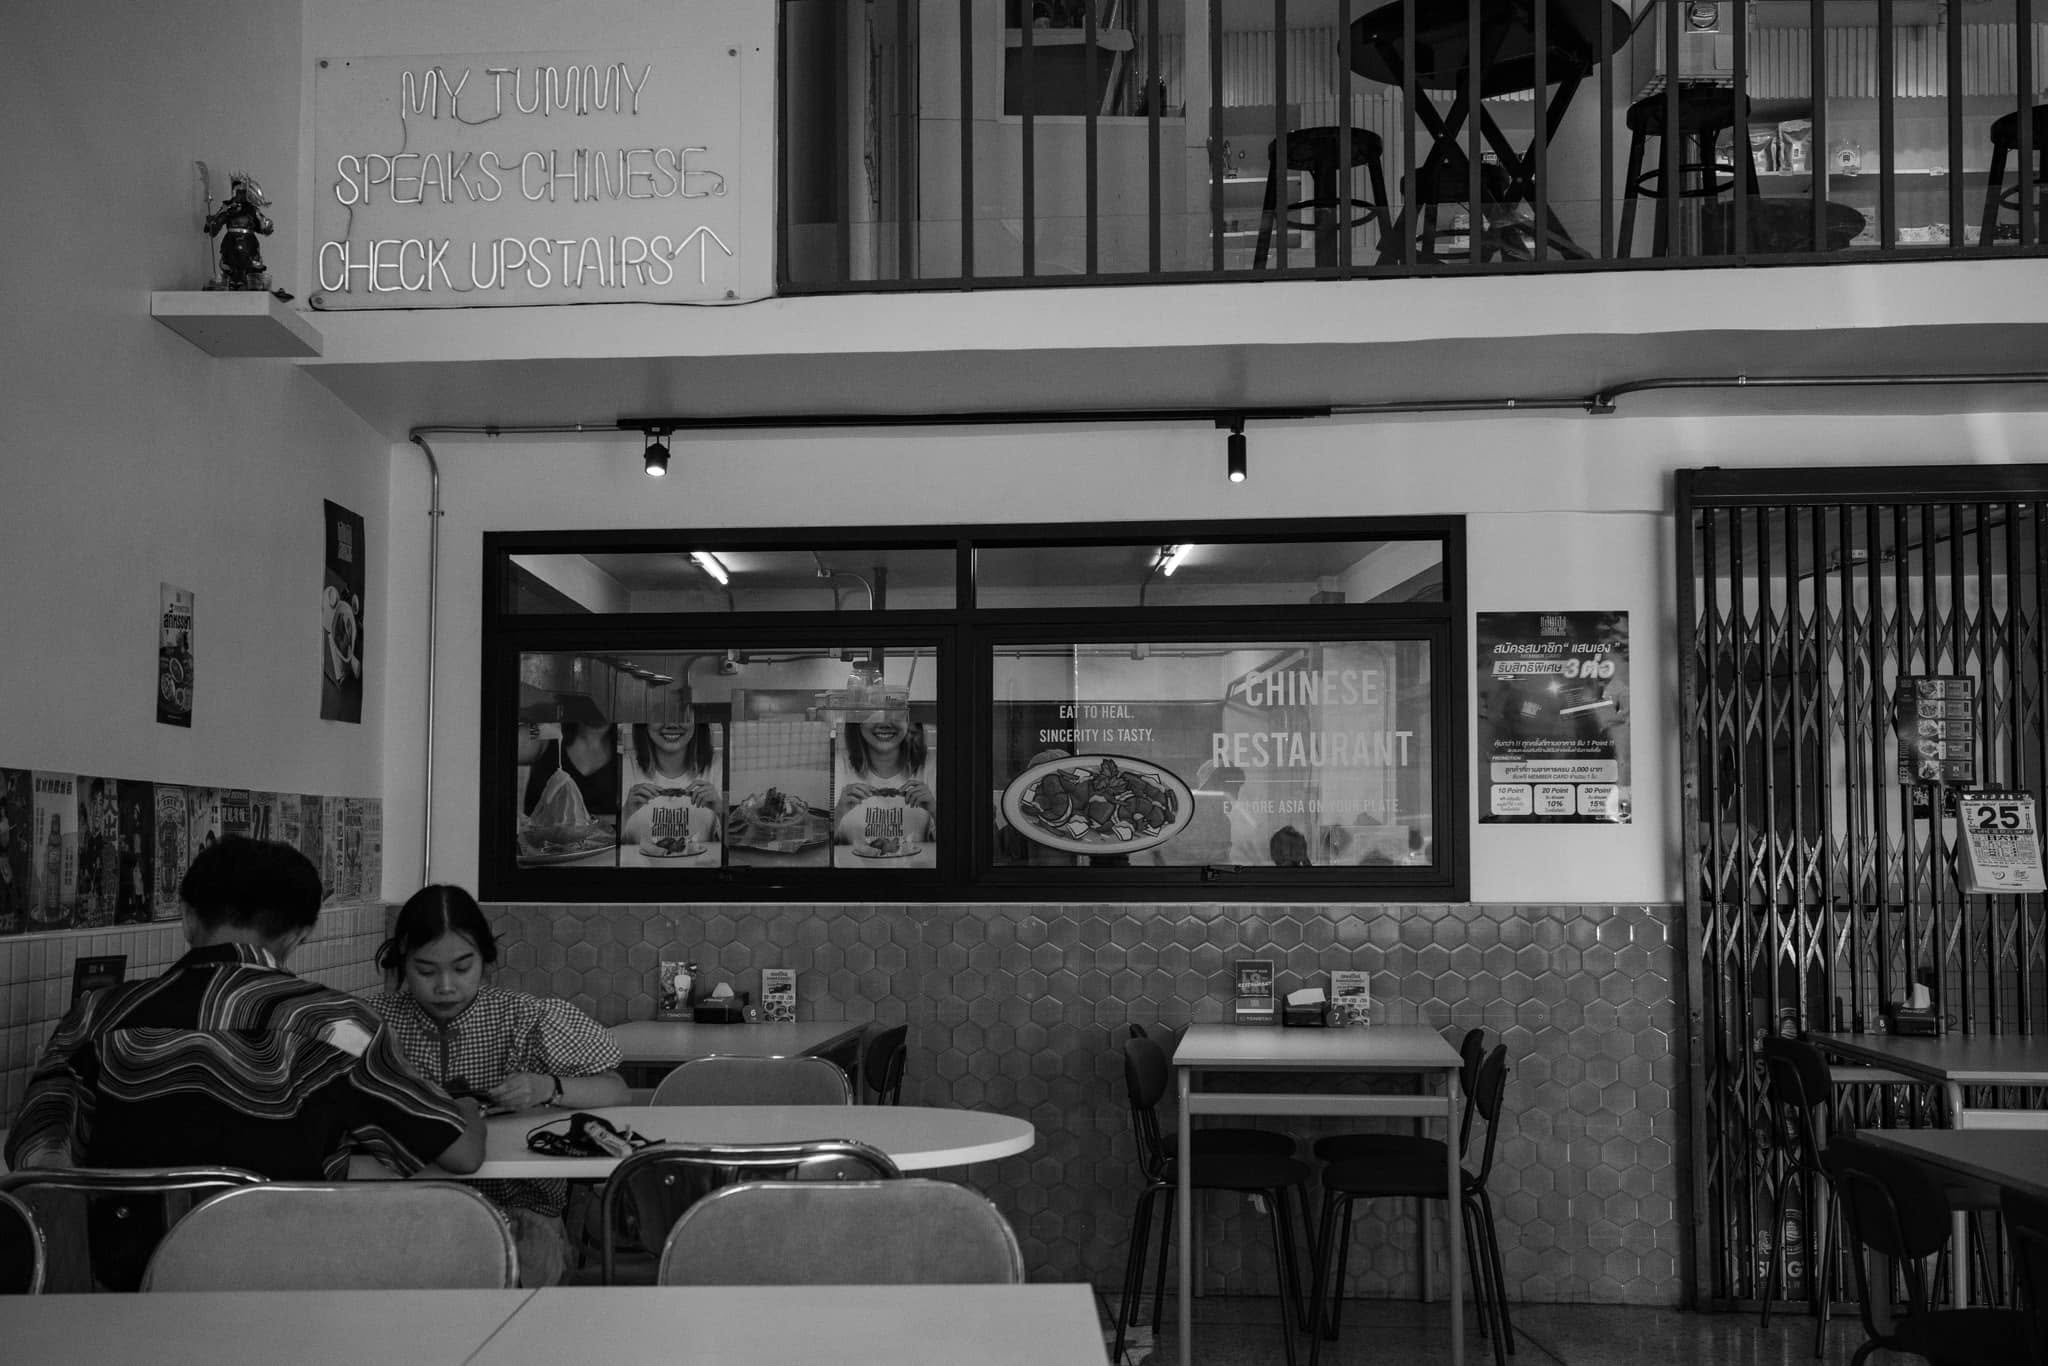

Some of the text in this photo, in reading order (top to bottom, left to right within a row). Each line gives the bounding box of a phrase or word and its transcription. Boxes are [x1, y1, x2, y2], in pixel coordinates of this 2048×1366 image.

[402, 62, 653, 118] MY TUMMY
[336, 146, 708, 205] SPEAKS CHINESE
[318, 235, 674, 293] CHECK UPSTAIRS
[1245, 670, 1379, 706] CHINESE
[1059, 704, 1135, 720] EAT TO HEAL.
[1039, 728, 1155, 744] SINCERITY IS TASTY.
[1212, 731, 1413, 769] RESTAURANT
[1223, 799, 1275, 814] ELORE
[1278, 799, 1305, 814] ASIA
[1977, 805, 2020, 829] 25
